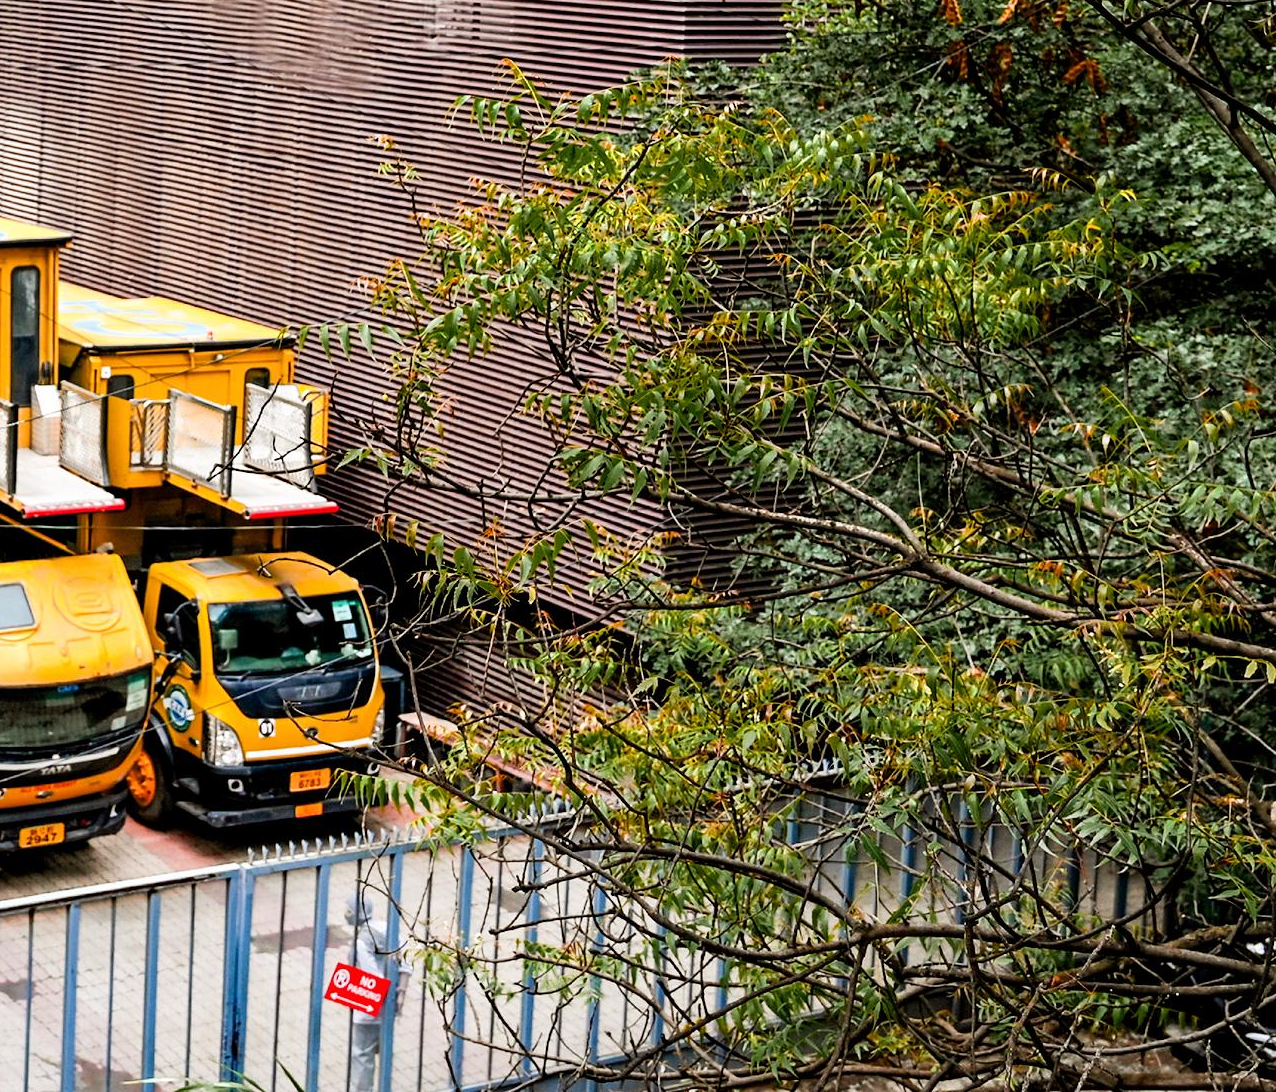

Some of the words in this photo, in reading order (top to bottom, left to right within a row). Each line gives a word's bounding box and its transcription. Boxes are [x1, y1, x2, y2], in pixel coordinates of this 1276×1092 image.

[41, 765, 71, 775] TATA
[26, 833, 57, 844] 2947
[359, 975, 377, 990] NO
